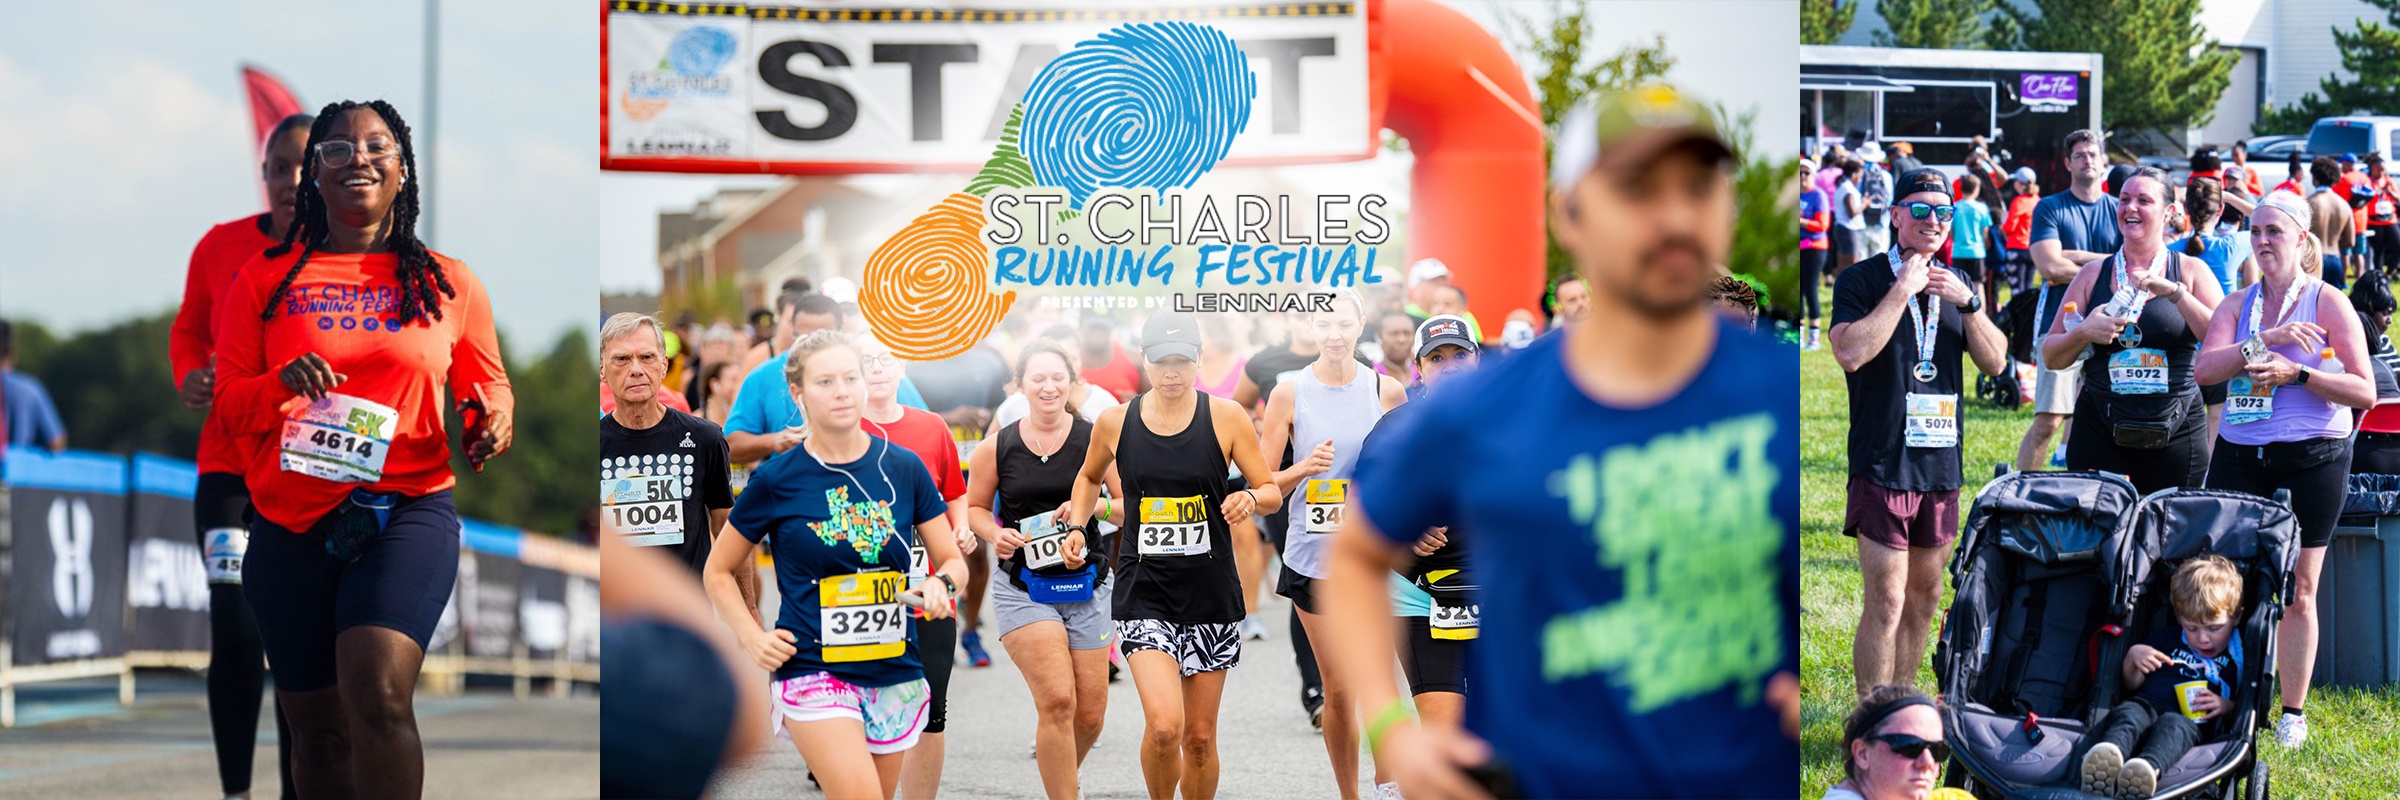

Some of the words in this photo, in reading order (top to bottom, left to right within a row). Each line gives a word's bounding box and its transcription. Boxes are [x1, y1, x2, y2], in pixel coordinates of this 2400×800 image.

[2126, 369, 2161, 378] 5072
[2235, 397, 2264, 408] 5073
[346, 407, 387, 439] 5K
[1925, 418, 1953, 429] 5074
[310, 429, 373, 458] 4614
[647, 479, 675, 501] 5K
[613, 504, 678, 527] 1004
[1176, 498, 1206, 524] 10K
[1311, 506, 1344, 525] 34
[1144, 526, 1205, 547] 3217
[1031, 536, 1067, 561] 10
[831, 608, 902, 635] 3294
